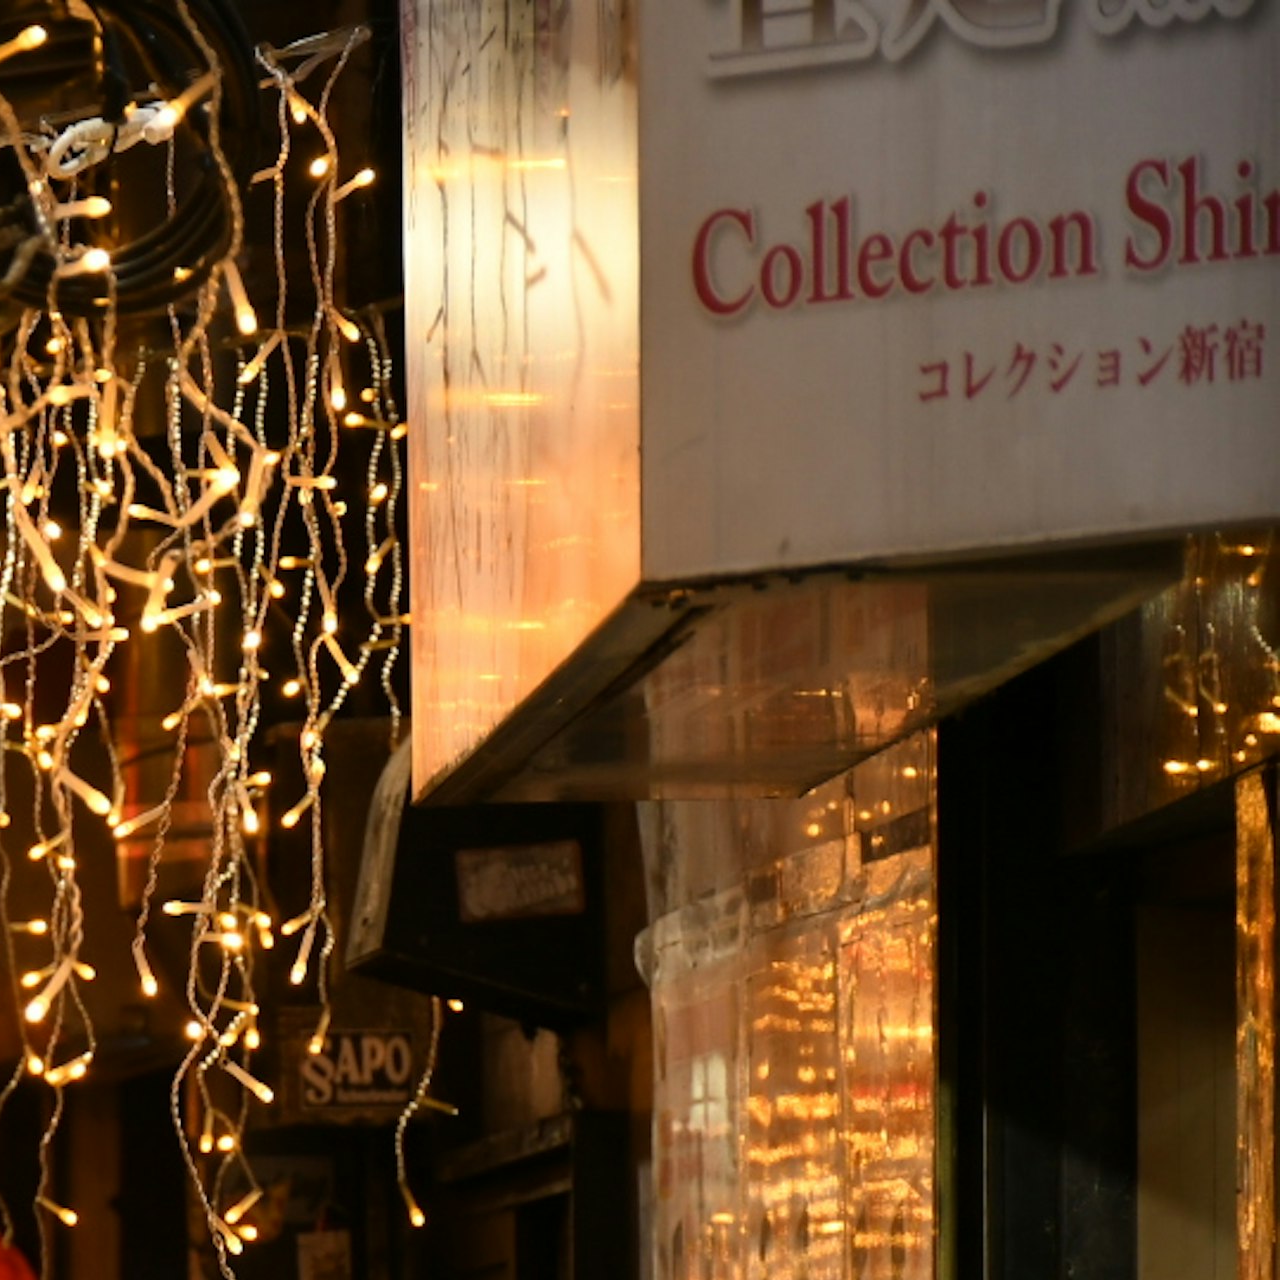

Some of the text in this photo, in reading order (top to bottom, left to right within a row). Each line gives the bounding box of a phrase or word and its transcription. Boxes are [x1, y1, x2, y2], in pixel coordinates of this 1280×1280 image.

[691, 191, 1098, 315] Collection
[919, 318, 1266, 403] コレクション新宿
